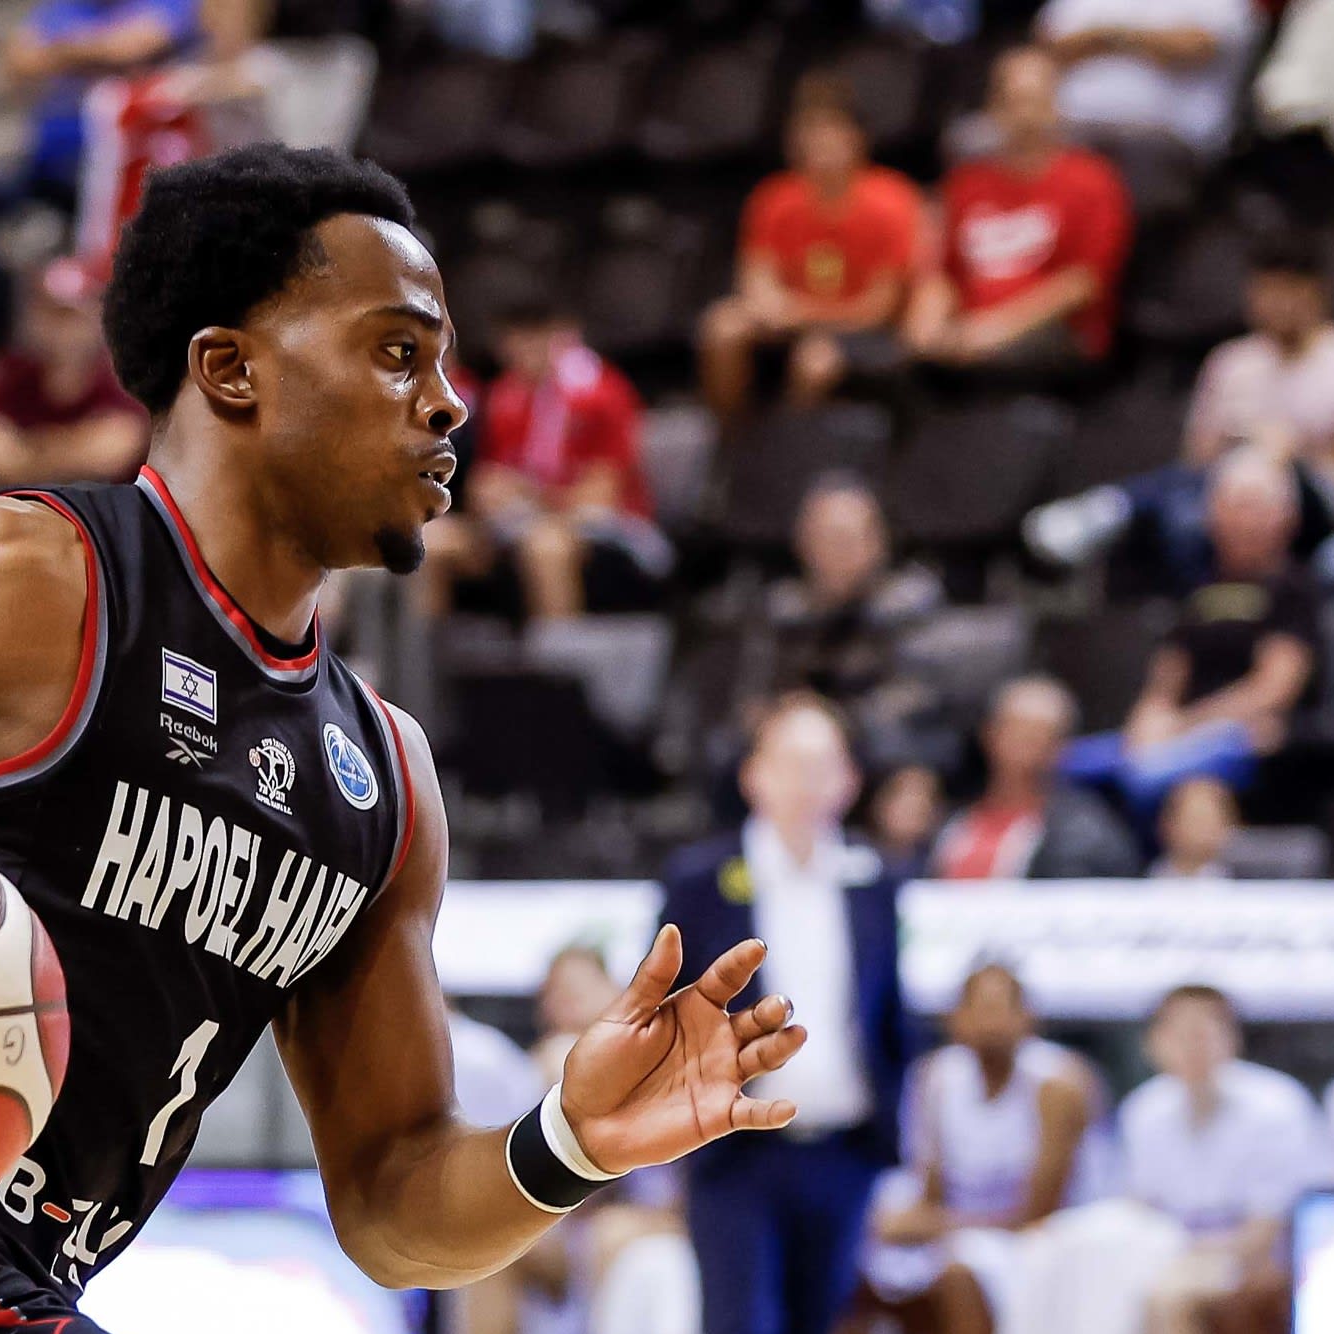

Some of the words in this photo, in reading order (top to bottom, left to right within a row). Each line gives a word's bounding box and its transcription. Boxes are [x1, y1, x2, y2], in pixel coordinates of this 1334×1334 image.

[160, 712, 218, 753] Reebok
[80, 780, 262, 962] HAPOEL
[139, 1018, 220, 1167] 1
